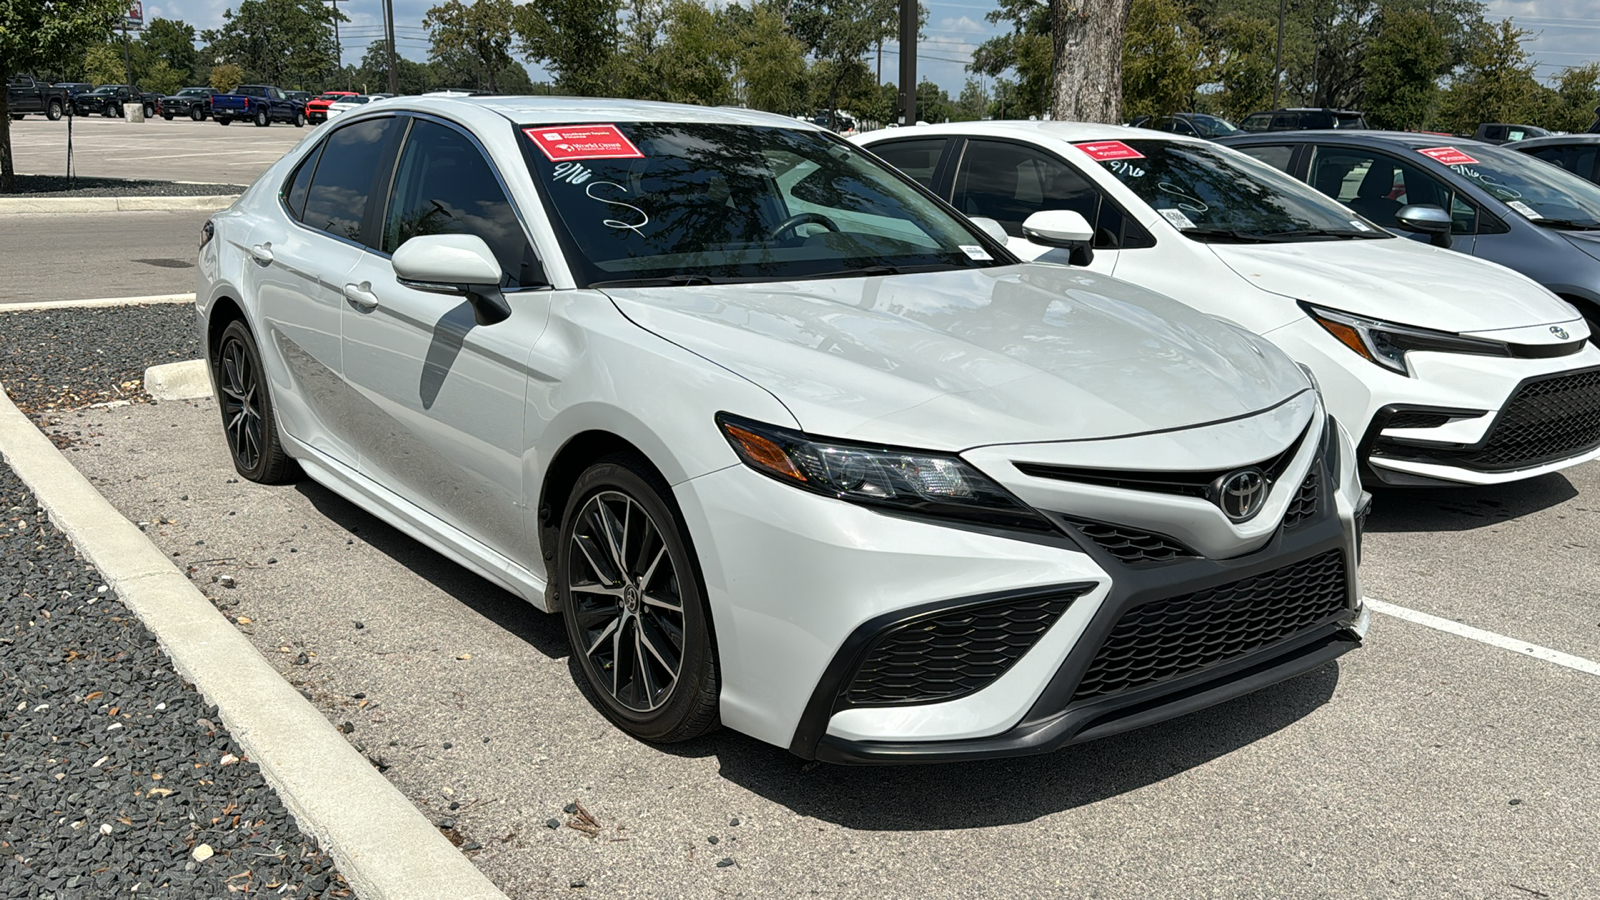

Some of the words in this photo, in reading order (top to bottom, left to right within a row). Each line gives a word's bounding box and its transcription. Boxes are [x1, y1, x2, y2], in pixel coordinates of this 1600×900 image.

[552, 162, 592, 185] 9/16
[1110, 160, 1145, 177] 9/16
[1450, 165, 1479, 177] 9/16
